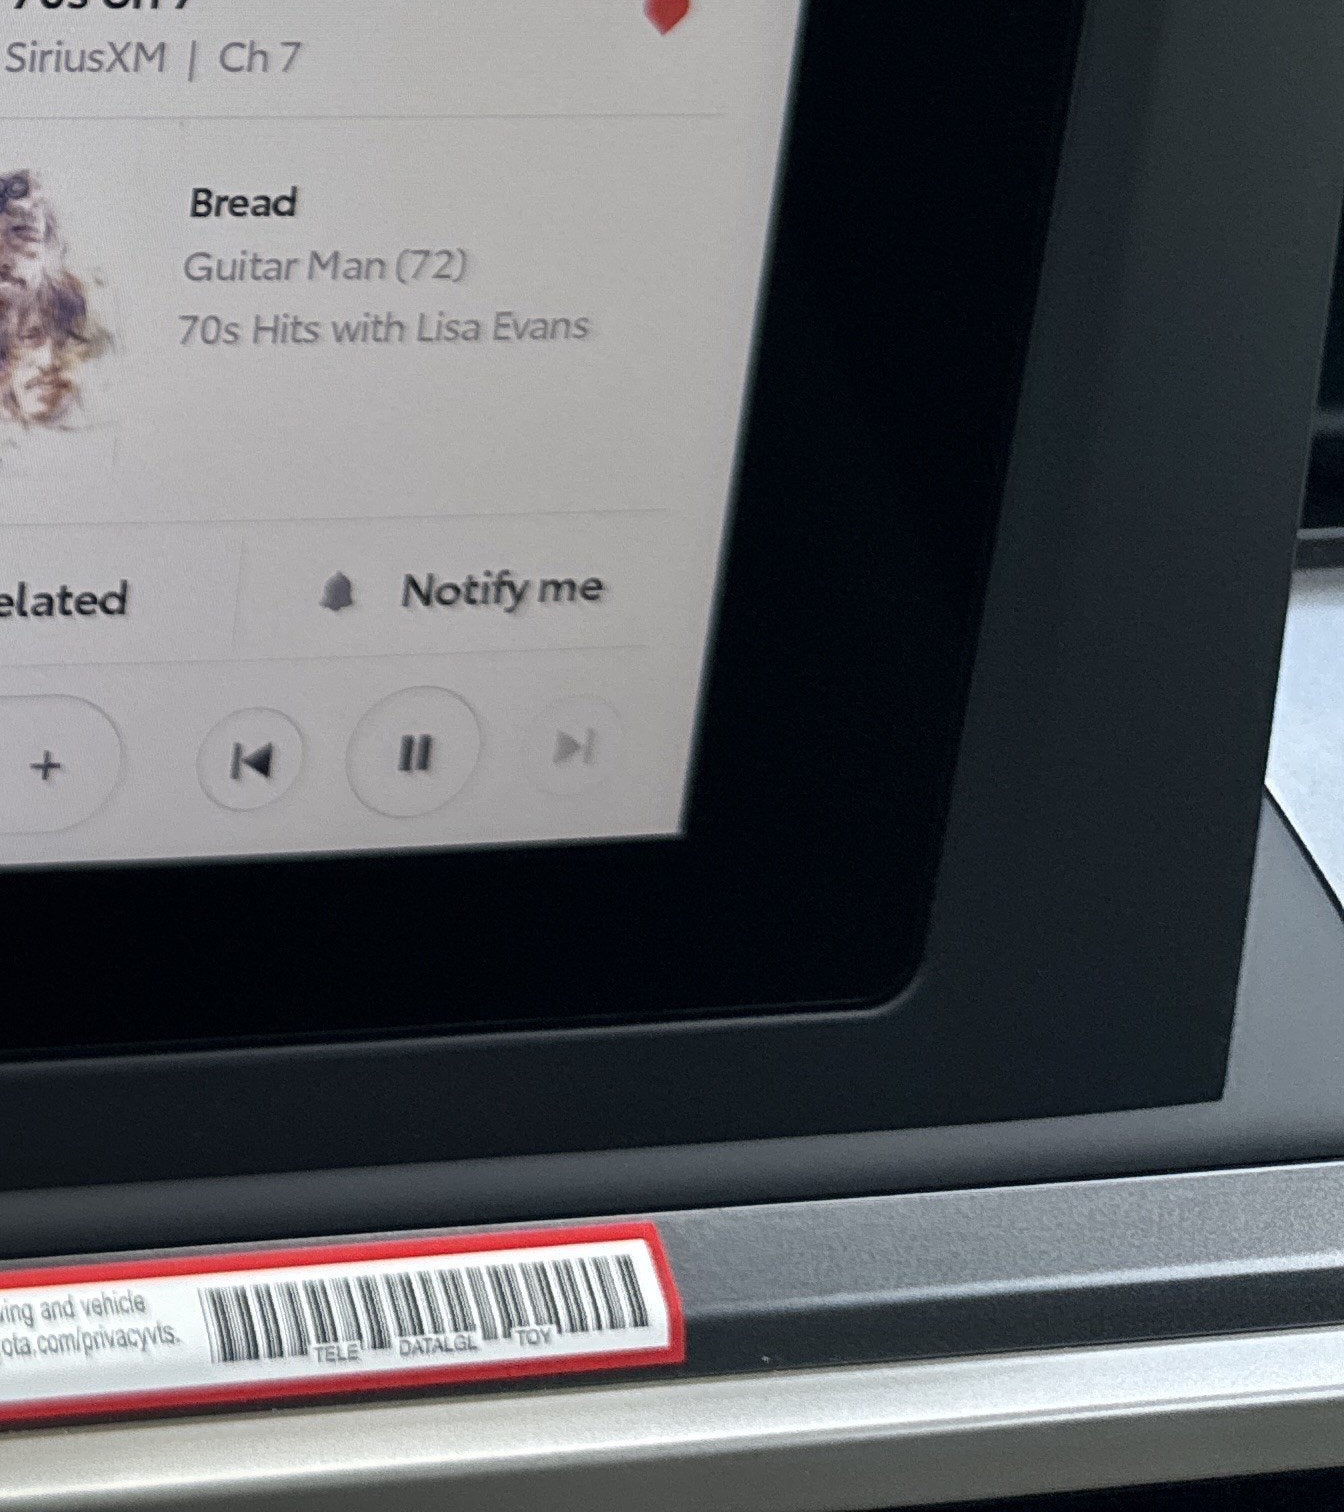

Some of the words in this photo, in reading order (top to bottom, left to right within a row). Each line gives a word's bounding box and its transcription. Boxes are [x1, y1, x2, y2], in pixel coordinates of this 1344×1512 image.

[5, 39, 165, 74] SiriusXM
[219, 39, 268, 74] Ch
[280, 41, 303, 73] 7
[189, 186, 298, 217] Bread
[184, 250, 299, 282] Guitar
[307, 250, 386, 281] Man
[395, 248, 468, 284] (72)
[179, 314, 240, 346] 70s
[252, 313, 319, 345] Hits
[331, 312, 405, 344] with
[416, 310, 481, 343] Lisa
[492, 310, 590, 342] Evans
[400, 571, 526, 615] Notify
[537, 578, 604, 604] me
[40, 1294, 75, 1320] and
[80, 1289, 146, 1317] vehicle
[314, 1343, 359, 1363] TELE
[515, 1328, 553, 1346] TOY
